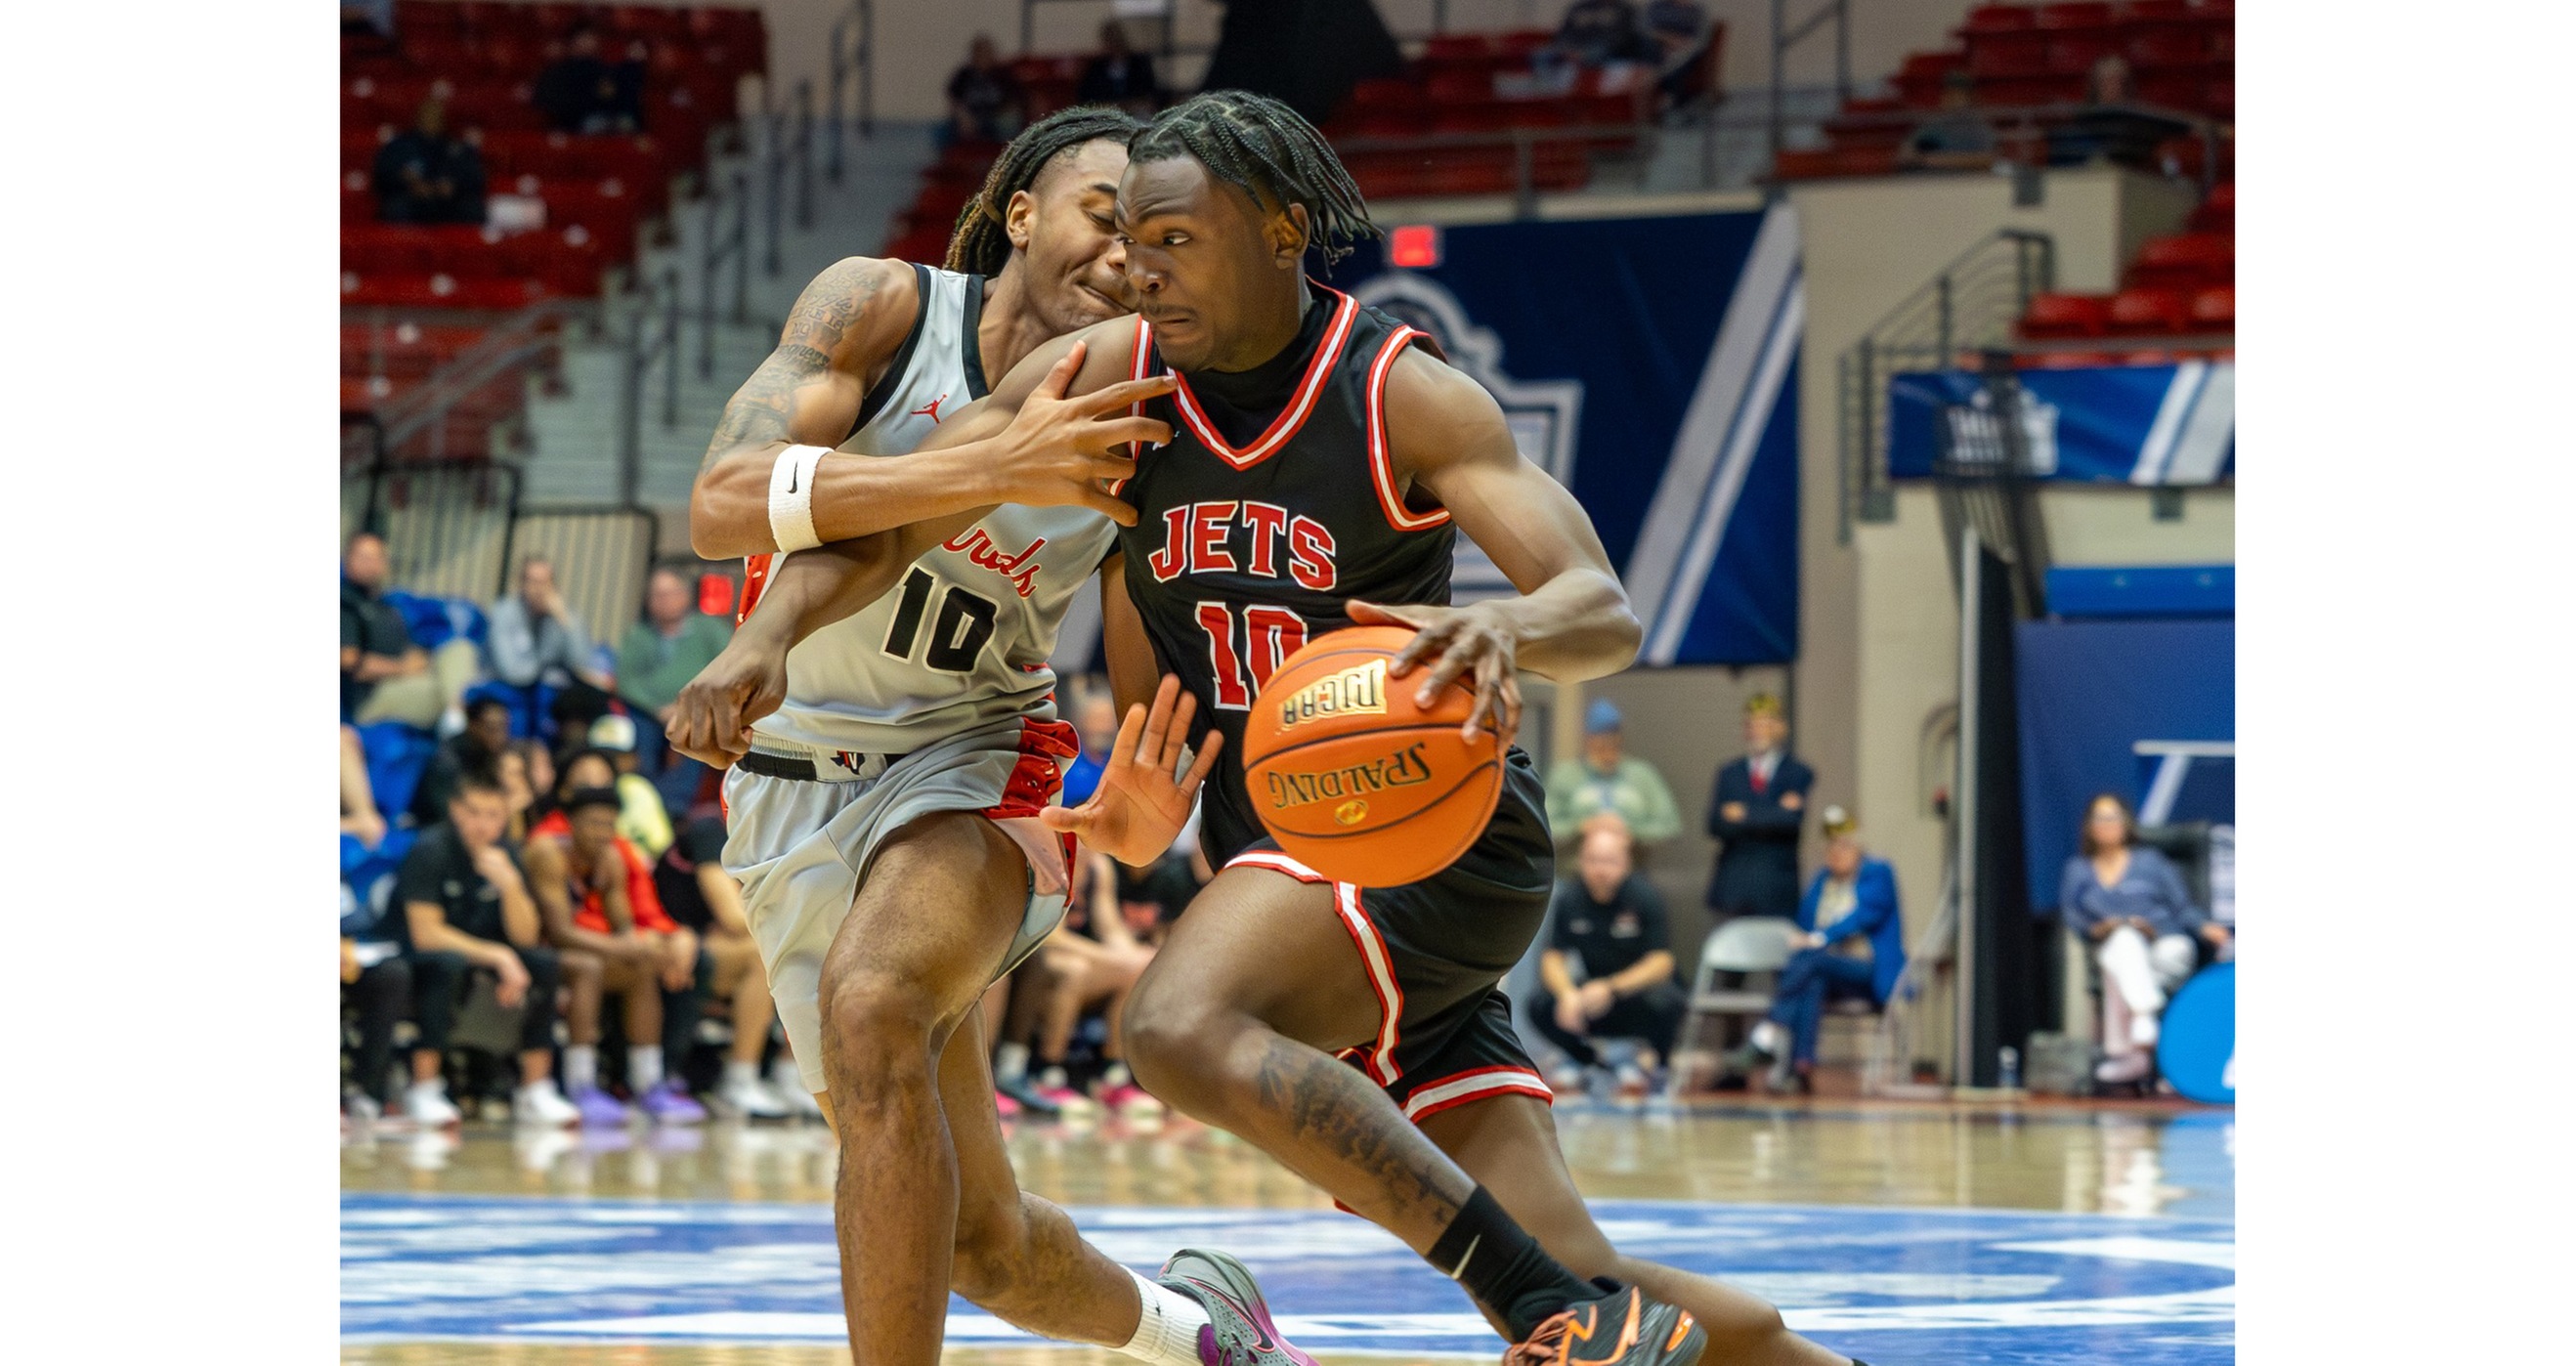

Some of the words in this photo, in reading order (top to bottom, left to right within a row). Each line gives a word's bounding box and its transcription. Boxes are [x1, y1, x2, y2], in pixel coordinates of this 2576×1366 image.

[1147, 499, 1337, 592] JETS
[879, 562, 1002, 677] 10
[1194, 600, 1309, 712] 10
[1280, 666, 1381, 725] NJCAA
[1267, 740, 1433, 810] SPALDING
